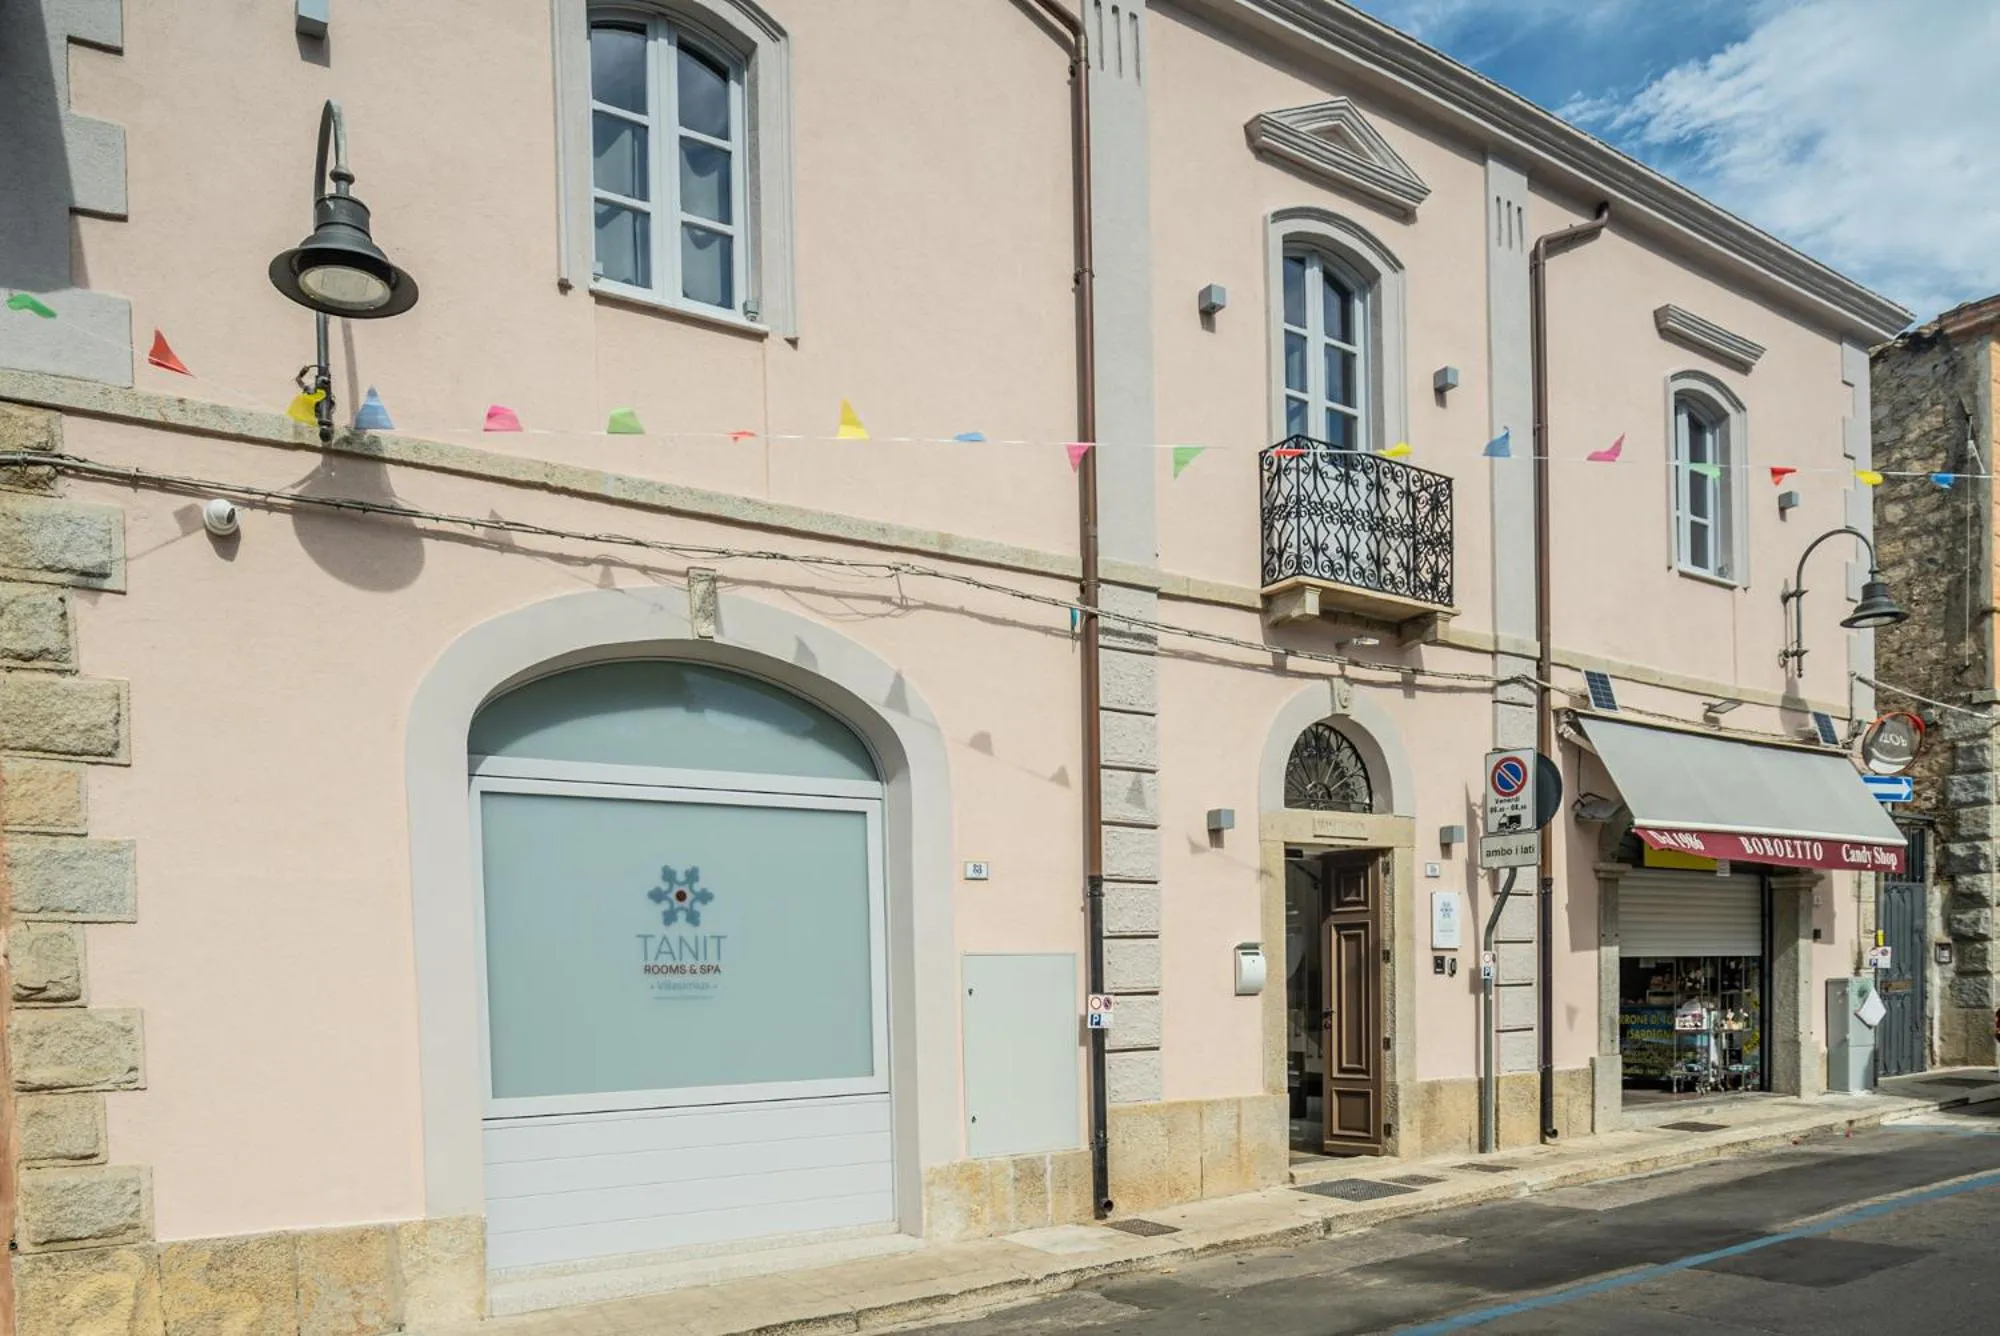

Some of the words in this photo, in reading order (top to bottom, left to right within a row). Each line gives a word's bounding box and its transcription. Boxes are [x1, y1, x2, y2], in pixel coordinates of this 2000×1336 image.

[1486, 847, 1513, 858] ambo
[1520, 843, 1535, 855] lati
[1738, 836, 1823, 861] BOBOETTO
[1841, 843, 1873, 868] Candy
[1874, 846, 1898, 871] Shop
[635, 934, 728, 961] TANIT
[643, 964, 687, 975] ROOMS
[689, 964, 698, 975] &
[699, 964, 722, 975] SPA
